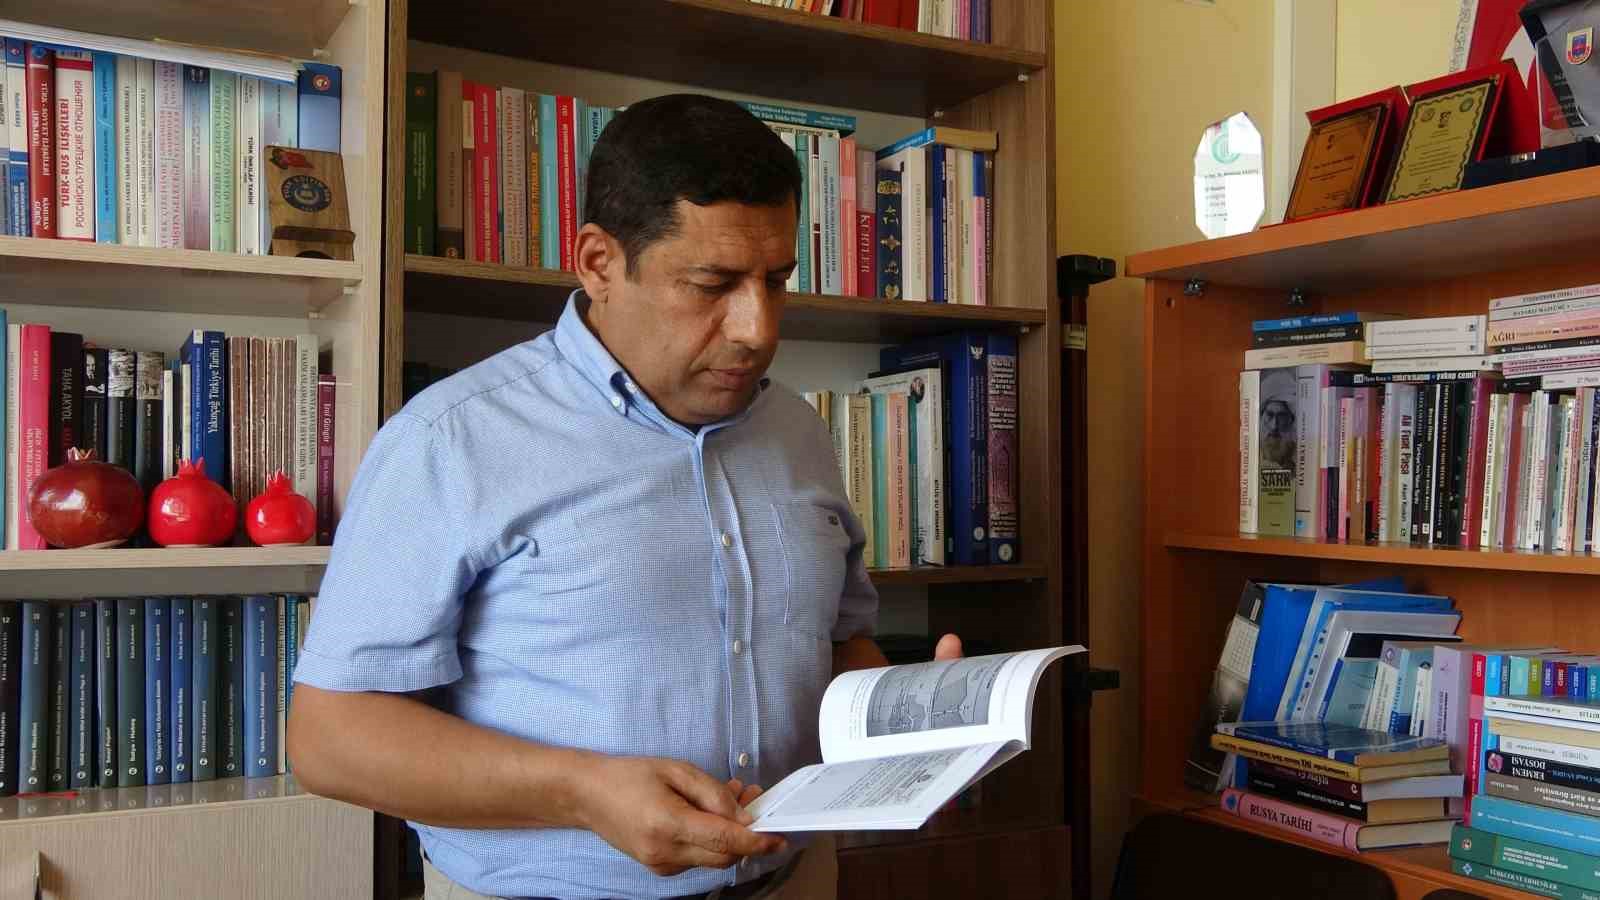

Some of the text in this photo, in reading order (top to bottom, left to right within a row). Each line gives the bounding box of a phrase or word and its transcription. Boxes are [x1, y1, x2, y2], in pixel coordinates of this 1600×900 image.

[59, 98, 70, 208] TÜRK-RUS İLİŞKİLERİ
[74, 80, 85, 228] РОССИЙСКО-ТУРЕЦКИЕ ОТНОШЕНИЯ
[207, 347, 218, 369] Tarihi
[62, 367, 72, 421] TAHA AKYOL
[207, 370, 219, 399] Türkiye
[207, 400, 221, 433] Yakınçağ
[1401, 429, 1412, 450] Fuat
[1511, 756, 1546, 769] DOSYASI
[1511, 766, 1545, 781] ERMENİ
[1249, 803, 1313, 833] RUSYA TARİHİ
